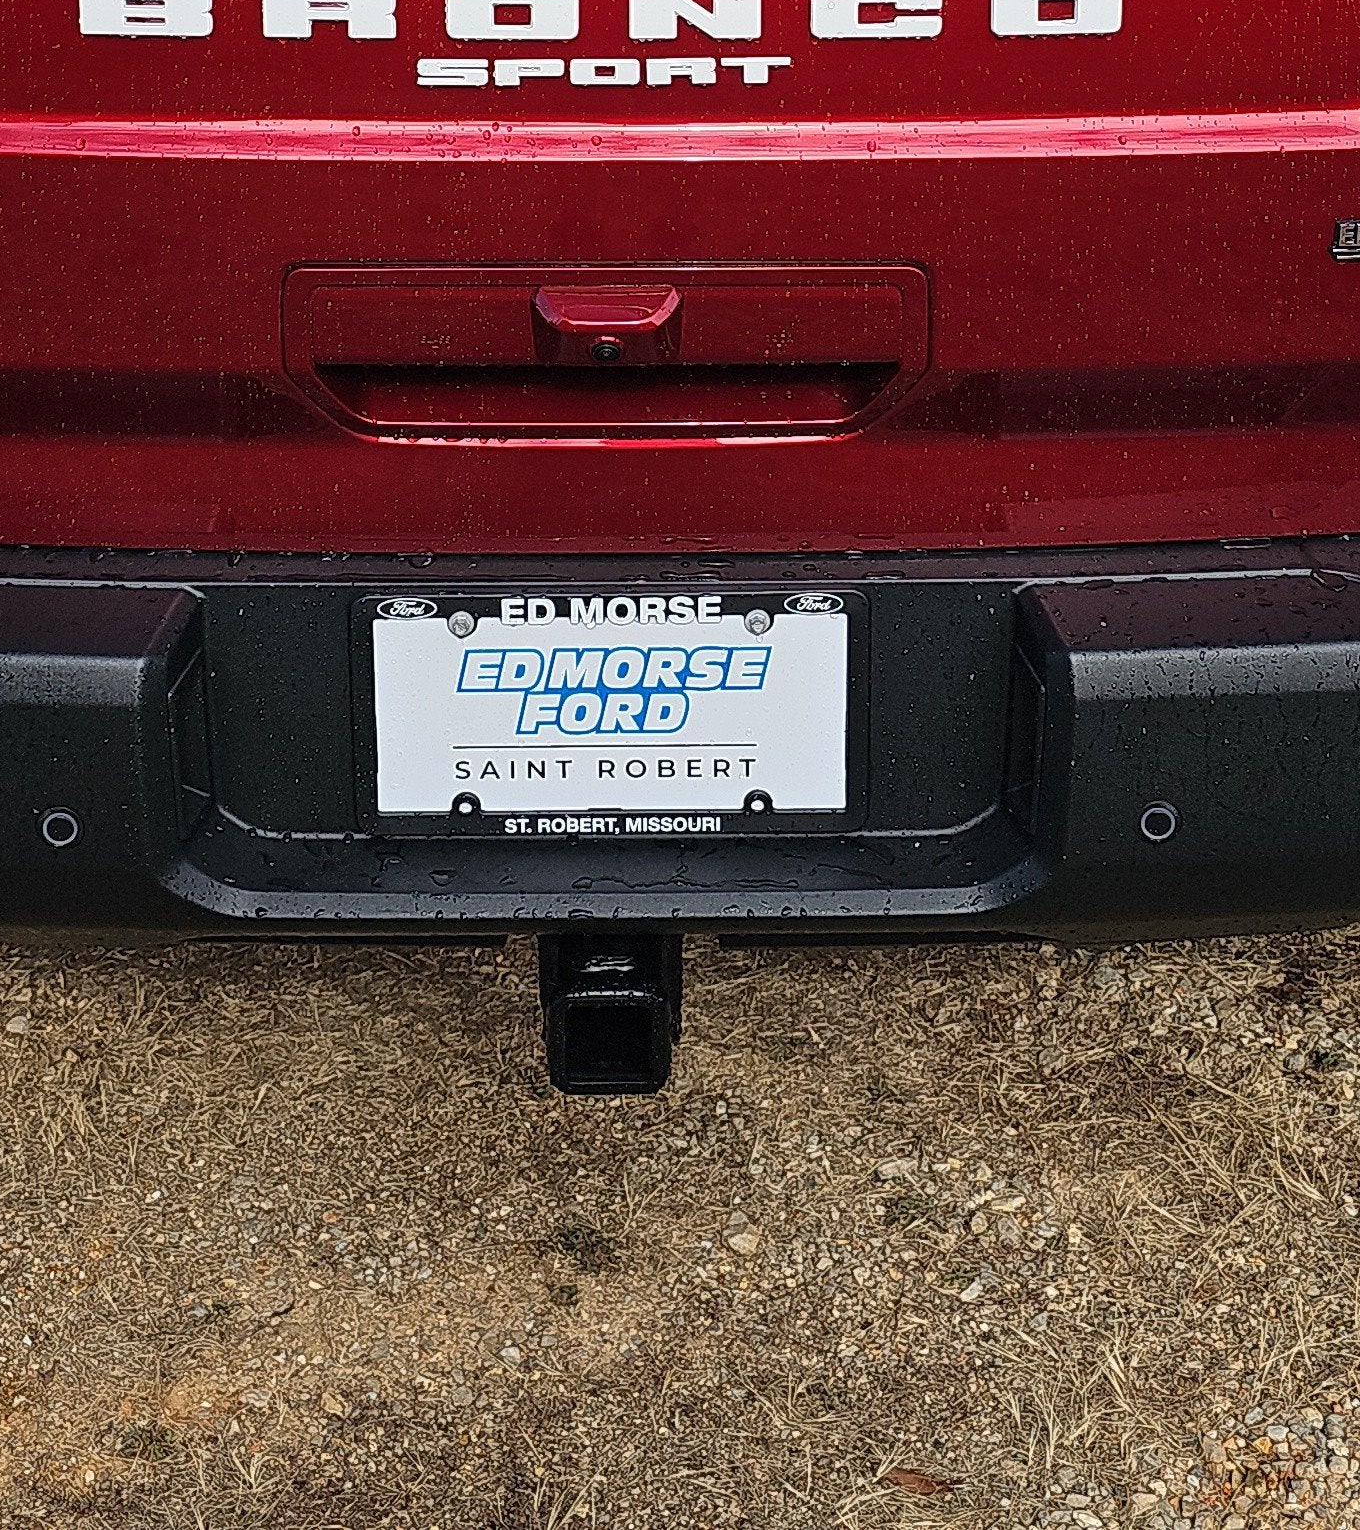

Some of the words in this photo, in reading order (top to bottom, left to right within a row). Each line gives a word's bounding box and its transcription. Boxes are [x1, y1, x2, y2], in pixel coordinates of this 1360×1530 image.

[415, 56, 792, 87] SPORT
[389, 600, 426, 617] Ford
[501, 596, 556, 626] ED
[570, 595, 723, 625] MORSE
[796, 595, 832, 611] Ford
[456, 646, 545, 693] ED
[542, 646, 772, 691] MORSE
[516, 691, 692, 736] FORD
[454, 760, 574, 780] SAINT
[598, 757, 759, 779] ROBERT
[504, 817, 533, 834] ST.
[537, 817, 620, 835] ROBERT,
[624, 816, 722, 834] MISSOURI
